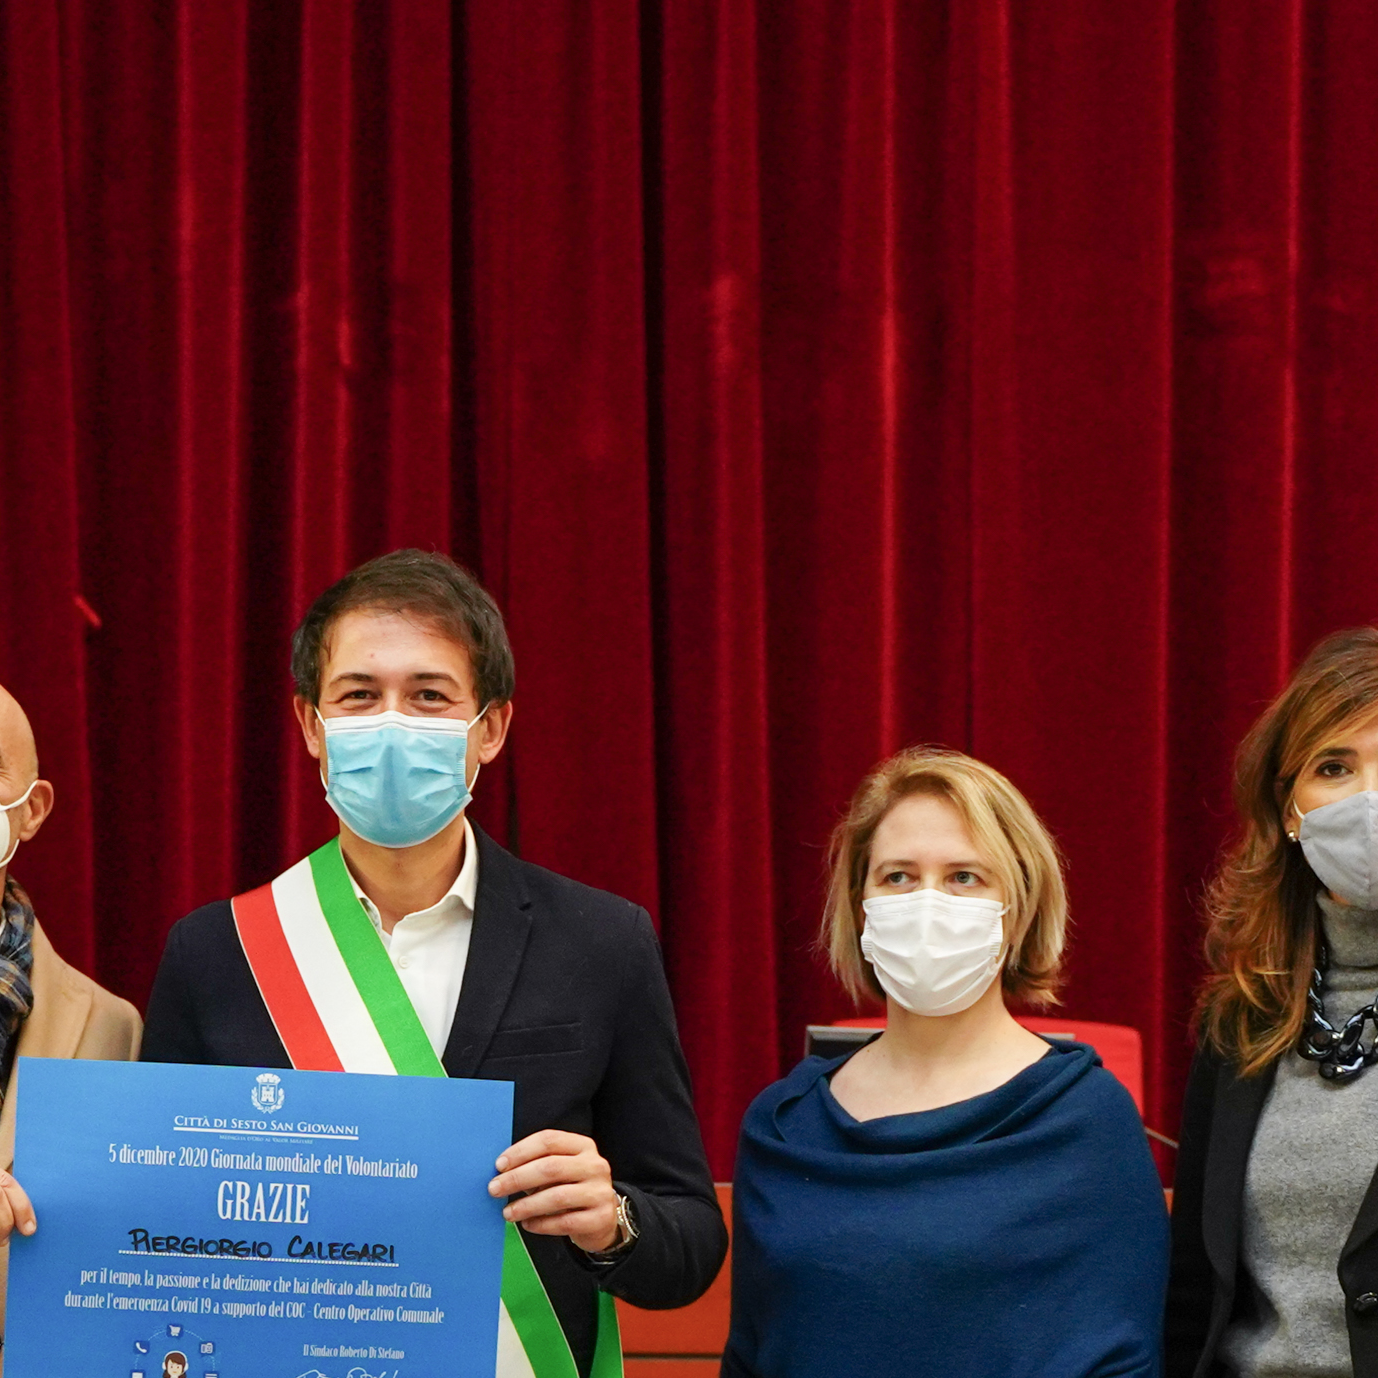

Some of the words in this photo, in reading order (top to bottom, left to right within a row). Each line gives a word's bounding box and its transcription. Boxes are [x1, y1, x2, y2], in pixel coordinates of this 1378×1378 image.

[231, 1118, 267, 1131] SESTO
[271, 1120, 293, 1132] SAN
[297, 1121, 359, 1136] GIOVANNI
[108, 1143, 117, 1163] 5
[119, 1144, 176, 1166] dicembre
[178, 1146, 208, 1168] 2020
[211, 1148, 263, 1171] Giornata
[266, 1152, 321, 1173] mondiale
[324, 1154, 342, 1175] del
[346, 1154, 419, 1179] Volontariato
[217, 1180, 311, 1224] GRAZIE
[128, 1228, 273, 1259] PIERGIORGIO
[286, 1235, 395, 1263] CALEGARI
[80, 1269, 98, 1286] per
[100, 1267, 108, 1284] il
[144, 1269, 154, 1286] la
[156, 1272, 201, 1289] passione
[202, 1275, 209, 1288] e
[211, 1273, 220, 1290] la
[223, 1274, 272, 1292] dedizione
[273, 1276, 292, 1293] che
[293, 1277, 310, 1294] hai
[311, 1278, 354, 1296] dedicato
[355, 1280, 374, 1297] alla
[376, 1282, 407, 1298] nostra
[409, 1281, 432, 1299] Città
[64, 1291, 105, 1309] durante
[107, 1293, 169, 1312] l'emergenza
[171, 1296, 198, 1313] Covid
[200, 1297, 212, 1314] 19
[213, 1302, 219, 1315] a
[221, 1302, 267, 1318] supporto
[268, 1301, 284, 1318] del
[286, 1302, 306, 1319] COC
[313, 1303, 346, 1320] Centro
[348, 1304, 394, 1324] Operativo
[396, 1305, 445, 1324] Comunale
[310, 1344, 338, 1358] Sindaco
[339, 1345, 368, 1358] Roberto
[369, 1346, 377, 1359] Di
[377, 1347, 405, 1360] Stefano
